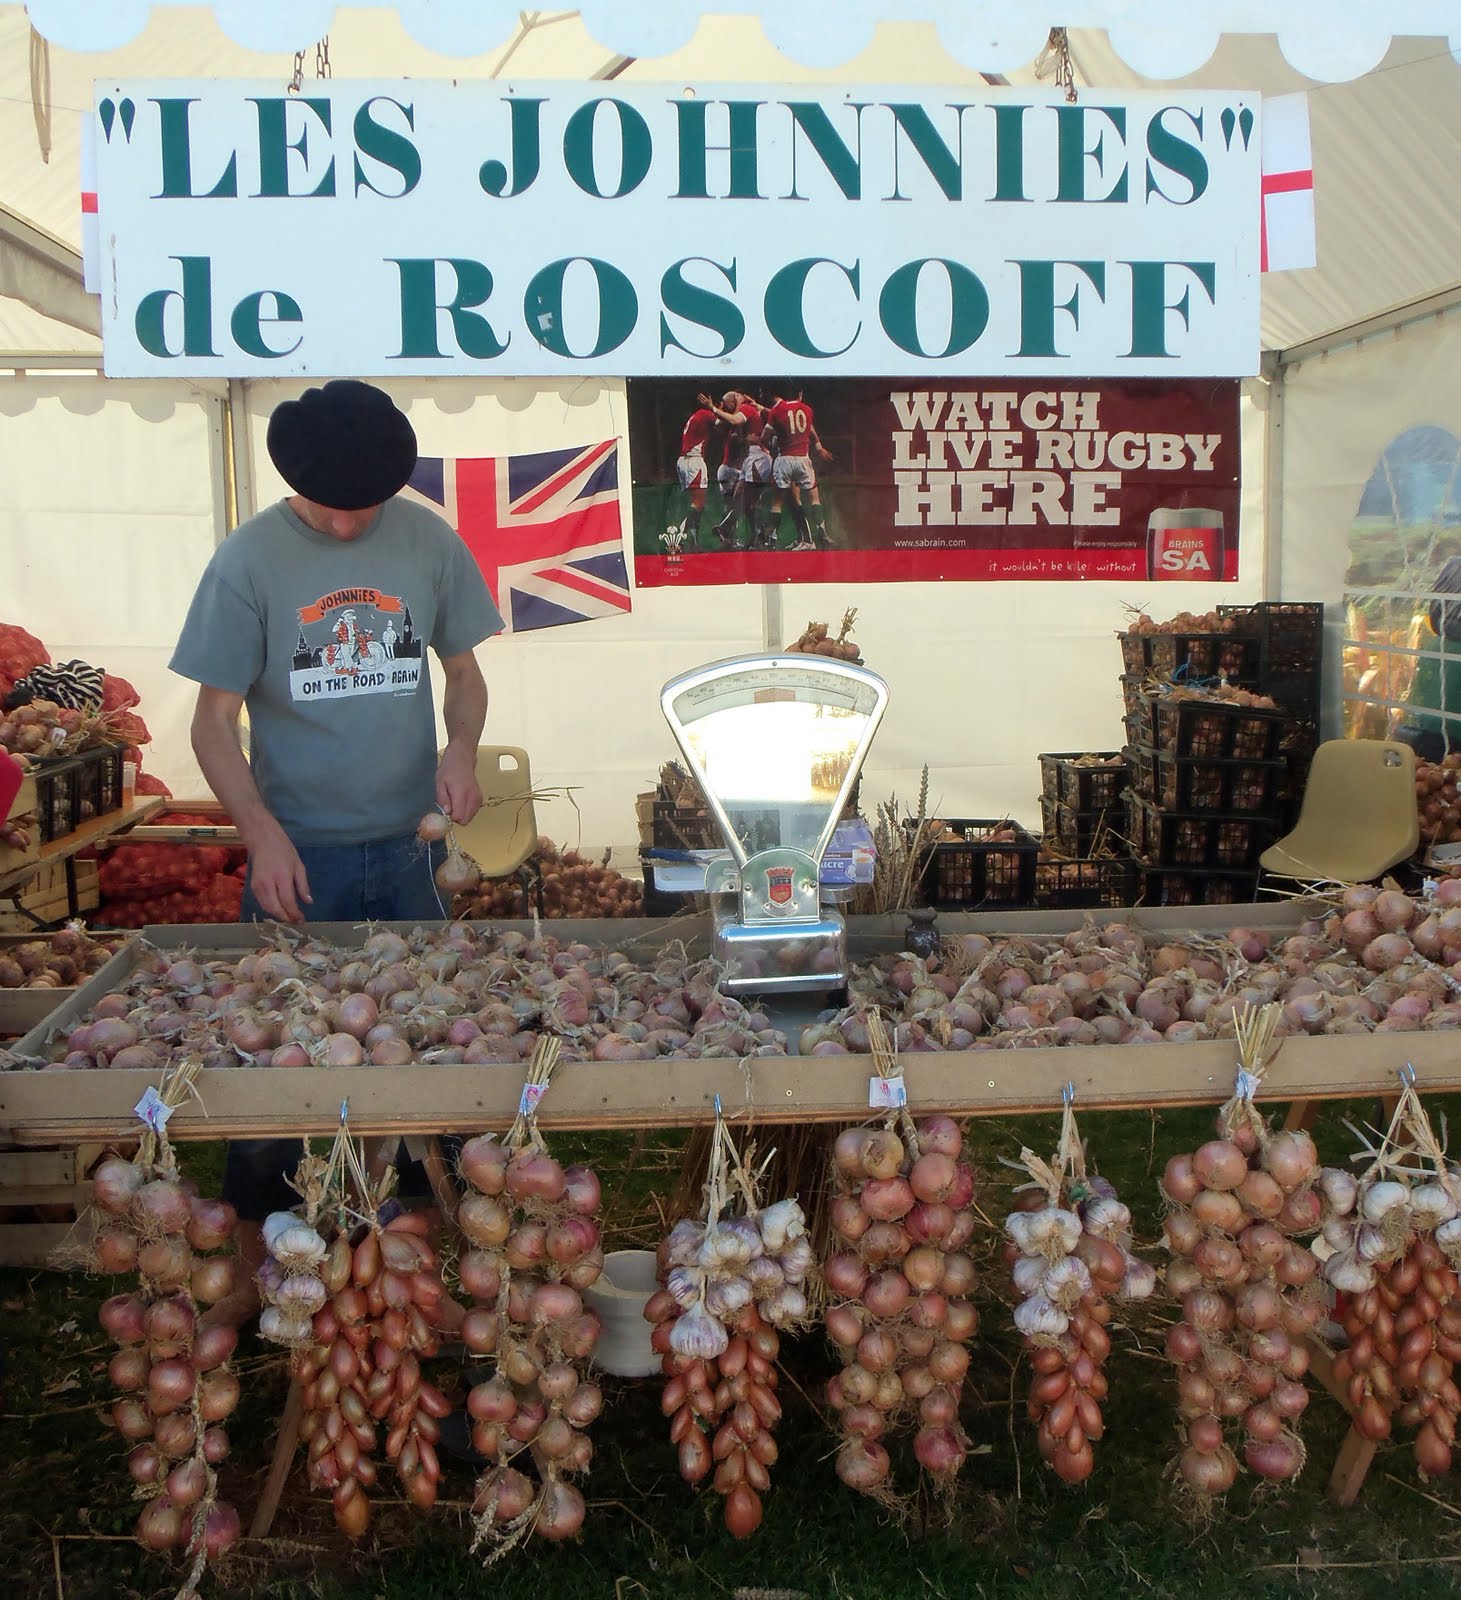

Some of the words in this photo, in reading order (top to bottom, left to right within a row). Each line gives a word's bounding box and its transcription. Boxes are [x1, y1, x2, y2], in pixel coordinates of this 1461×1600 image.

[99, 96, 422, 199] "LES
[478, 96, 1254, 205] JOHNNIES"
[135, 256, 304, 359] de
[383, 256, 1217, 360] ROSCOFF
[787, 409, 807, 434] 10
[890, 391, 1101, 430] WATCH
[892, 431, 1023, 469] LIVE
[1035, 431, 1222, 471] RUGBY
[894, 471, 1121, 526] HERE
[894, 538, 966, 547] www.sabrain.com
[1107, 540, 1137, 548] responsibly
[1168, 540, 1204, 549] BRAINS
[989, 560, 998, 571] it
[1003, 559, 1046, 571] wouldn't
[1051, 560, 1063, 571] be
[1096, 560, 1137, 571] without
[1161, 550, 1211, 571] SA
[303, 680, 322, 695] ON
[325, 677, 347, 692] THE
[353, 672, 386, 689] ROAD
